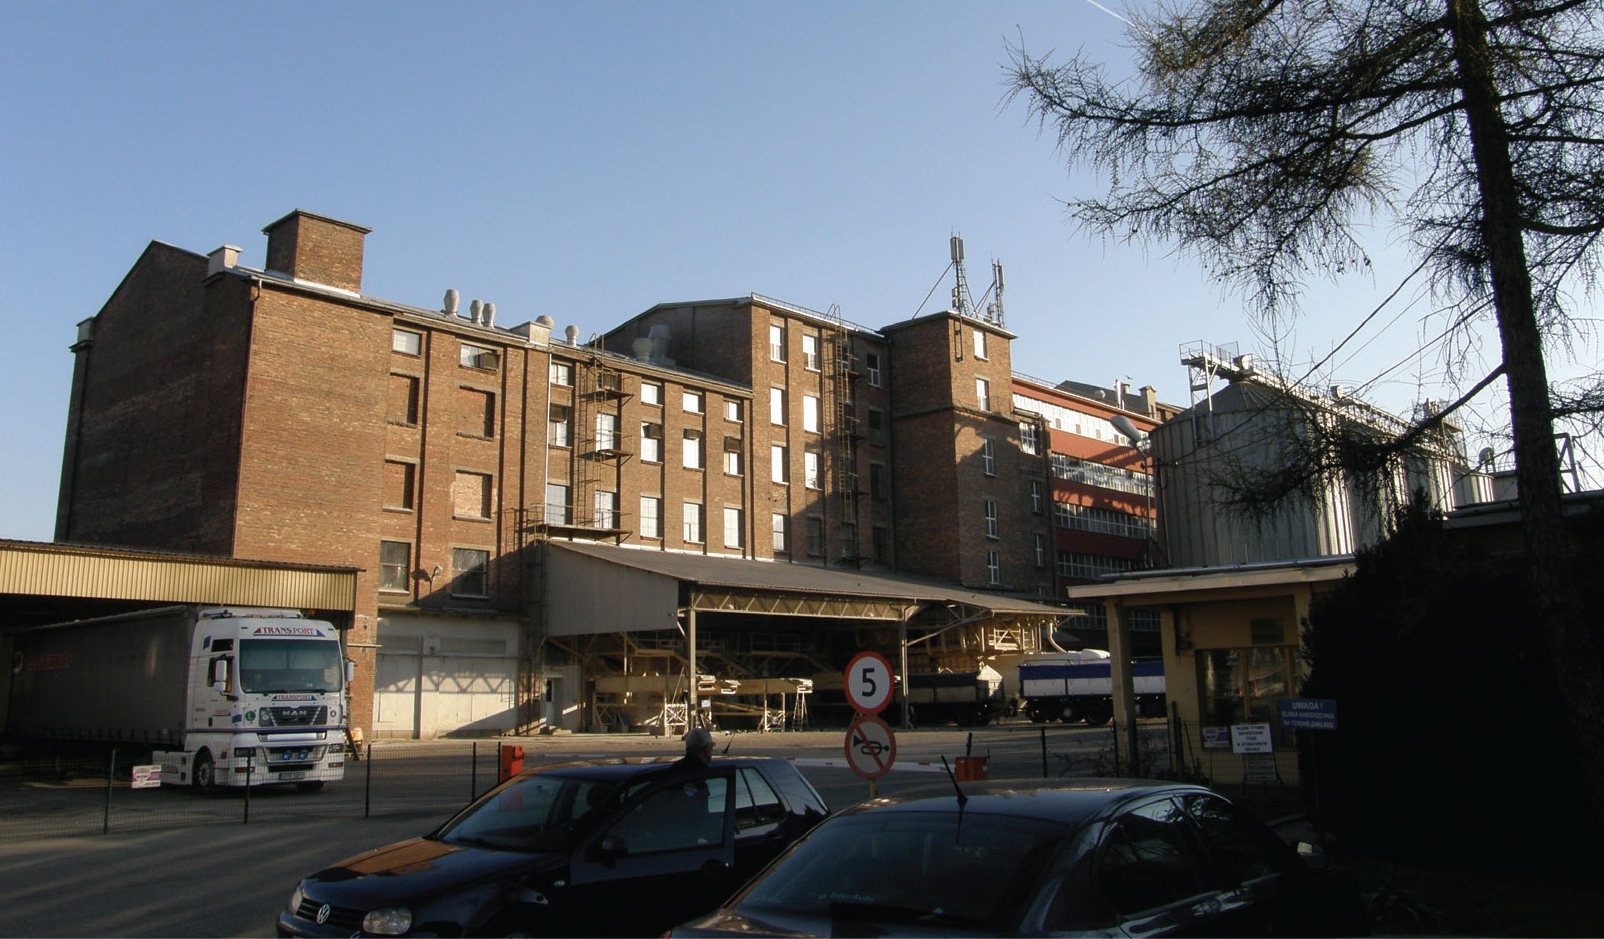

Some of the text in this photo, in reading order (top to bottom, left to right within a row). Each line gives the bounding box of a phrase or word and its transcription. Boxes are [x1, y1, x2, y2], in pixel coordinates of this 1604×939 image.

[262, 626, 315, 634] TRANSPORT
[861, 667, 877, 697] 5
[1292, 701, 1319, 710] UWAGA
